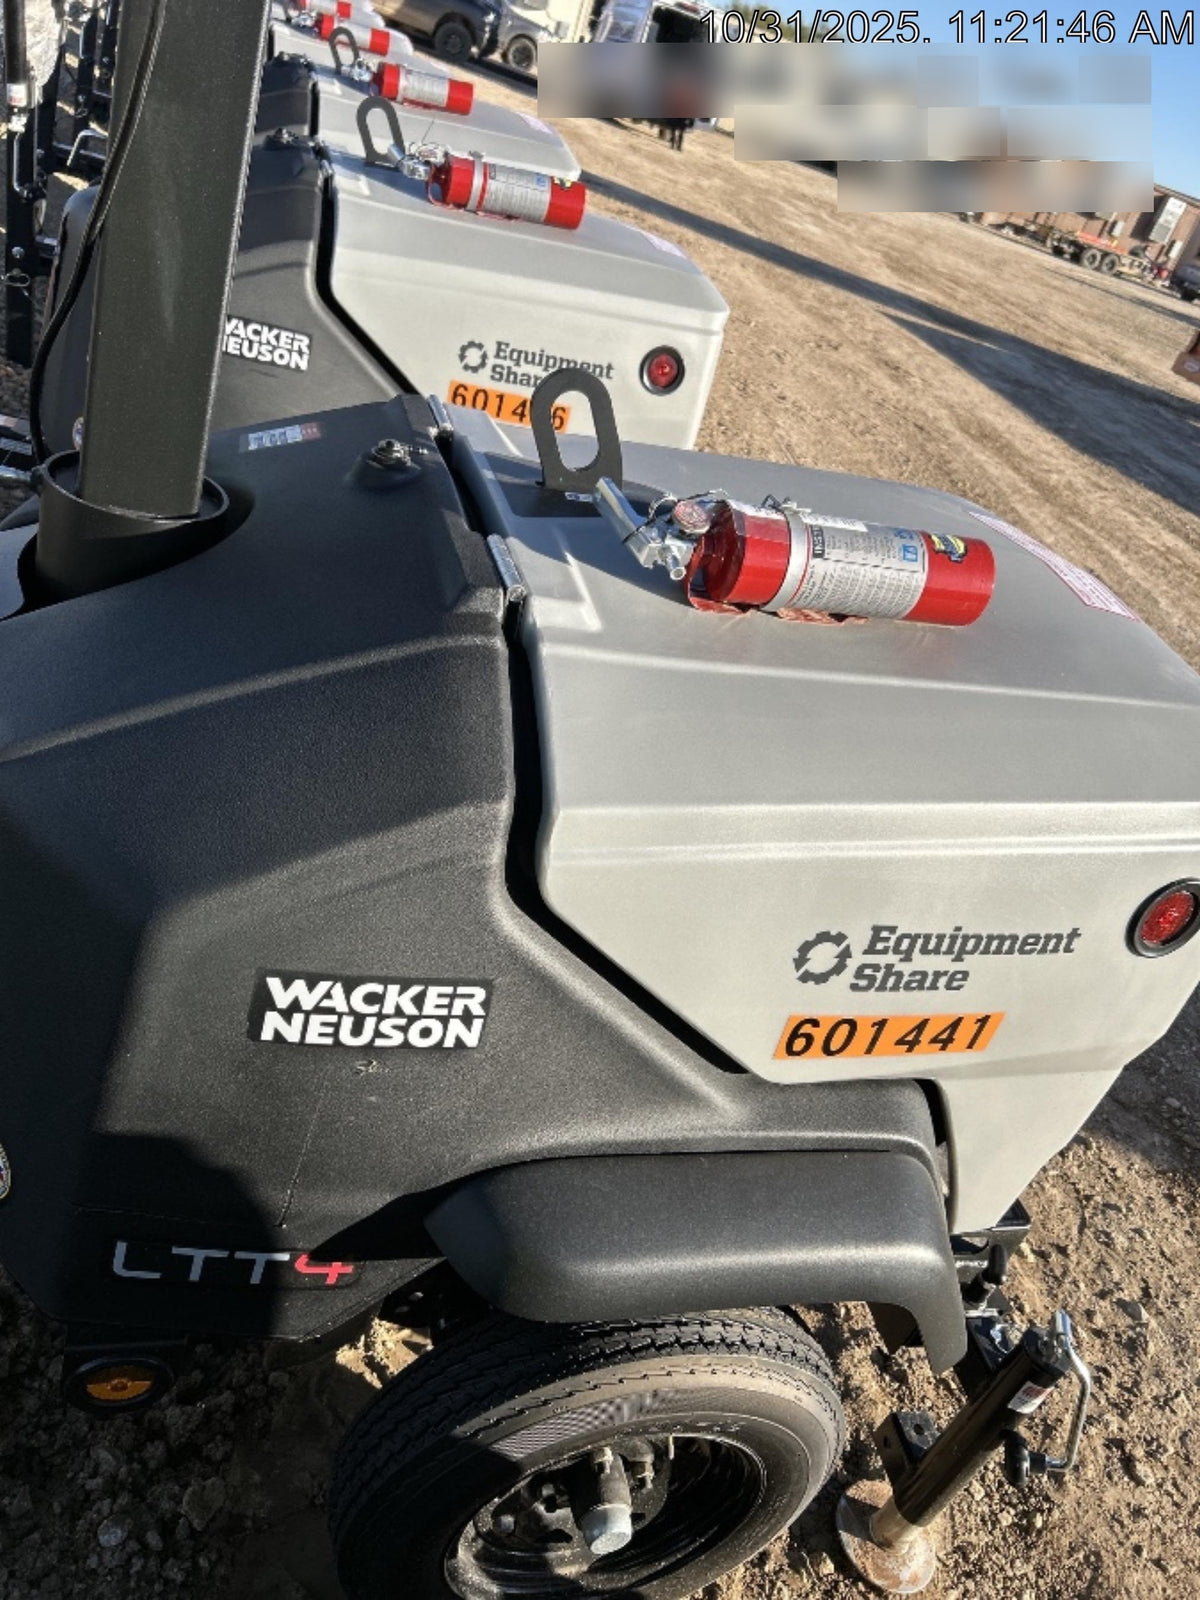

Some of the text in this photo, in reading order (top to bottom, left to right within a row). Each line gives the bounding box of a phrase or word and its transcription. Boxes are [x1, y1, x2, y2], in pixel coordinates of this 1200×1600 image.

[222, 335, 309, 371] EUSON
[490, 364, 543, 387] Shar
[451, 383, 567, 431] 60146
[862, 924, 1082, 963] Equipment
[265, 976, 487, 1016] WACKER
[849, 962, 970, 993] Share
[260, 1010, 485, 1048] NEUSON
[784, 1014, 991, 1057] 601441
[112, 1240, 354, 1284] LTT4
